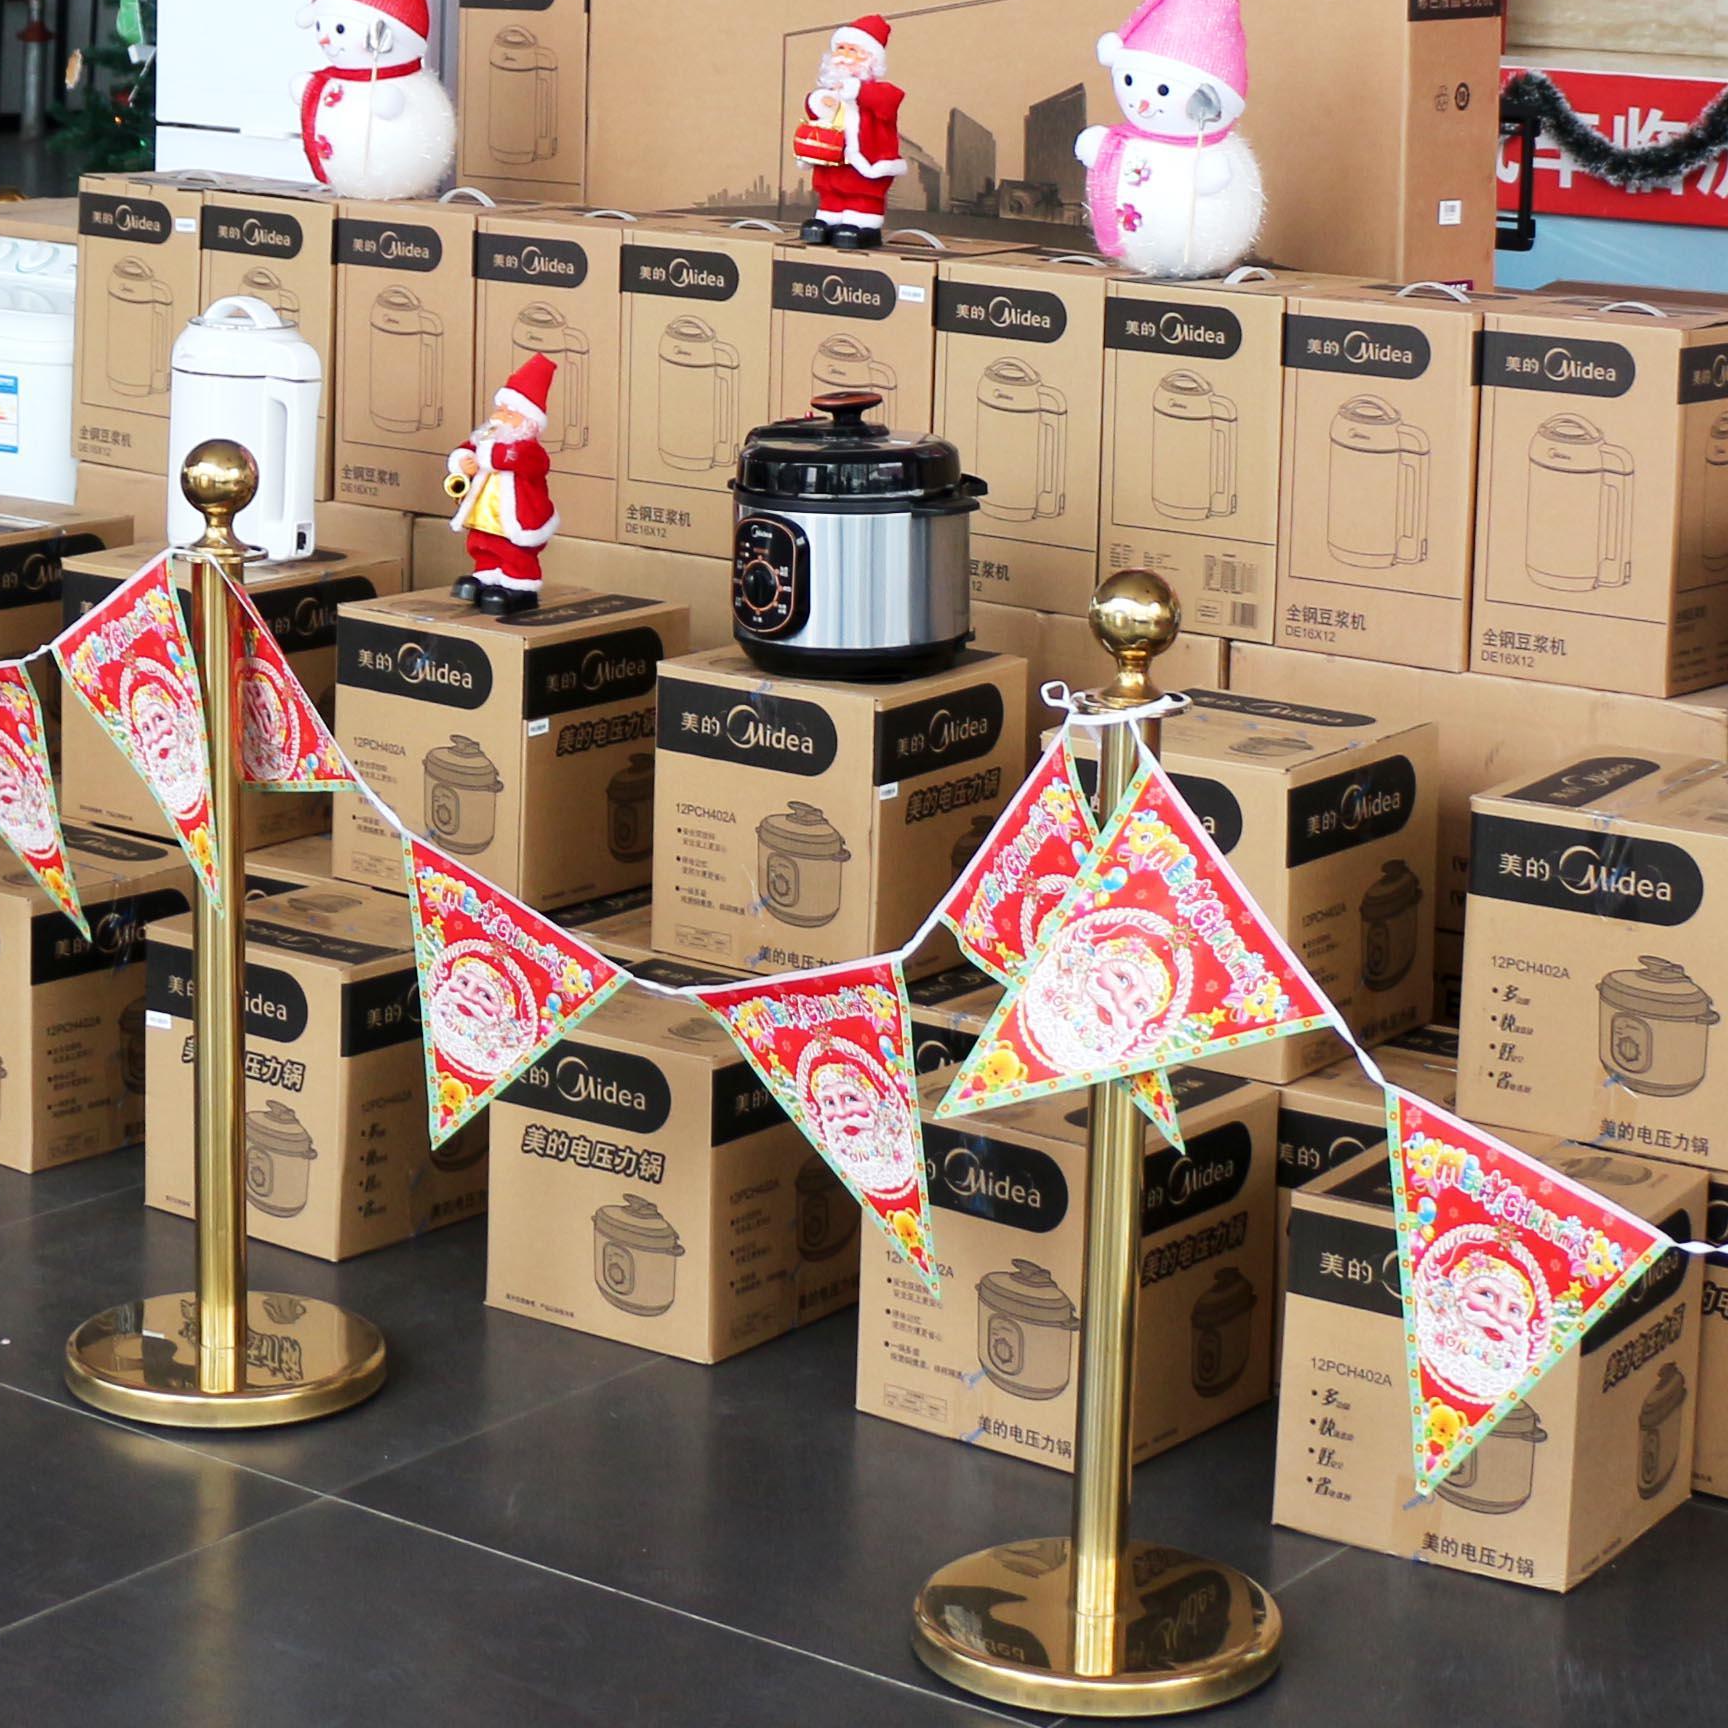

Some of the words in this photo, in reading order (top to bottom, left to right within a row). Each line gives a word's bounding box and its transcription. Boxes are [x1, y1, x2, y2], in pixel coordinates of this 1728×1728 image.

[91, 209, 114, 227] 美的
[114, 203, 162, 235] Midea
[216, 221, 241, 241] 美的
[243, 217, 291, 250] Midea
[351, 235, 377, 254] 美的
[379, 230, 430, 262] Midea
[491, 251, 519, 269] 美的
[520, 245, 575, 277] Midea
[638, 265, 666, 283] 美的
[669, 258, 726, 292] Midea
[791, 282, 819, 299] 美的
[822, 274, 881, 307] Midea
[955, 302, 986, 322] 美的
[988, 295, 1051, 330] Midea
[1124, 318, 1156, 337] 美的
[1159, 311, 1227, 346] Midea
[1306, 337, 1339, 357] 美的
[1343, 330, 1413, 365] Midea
[1504, 354, 1540, 375] 美的
[1544, 347, 1617, 383] Midea
[77, 424, 133, 449] 全钢豆浆机
[340, 464, 401, 489] 全钢豆浆机
[624, 521, 668, 540] DE16X12
[625, 503, 692, 529] 全钢豆浆机
[1284, 625, 1336, 644] DE16X12
[1285, 604, 1367, 632] 全钢豆浆机
[1480, 648, 1535, 669] DE16X12
[1481, 627, 1567, 658] 全钢豆浆机
[357, 648, 393, 671] 美的
[397, 642, 473, 689] Midea
[545, 670, 578, 692] 美的
[580, 648, 647, 690] Midea
[352, 734, 407, 757] 12PCH402A
[556, 712, 656, 757] 美的电压力锅
[680, 711, 720, 736] 美的
[725, 703, 814, 756] Midea
[896, 733, 925, 757] 美的
[928, 708, 989, 754] Midea
[675, 801, 737, 825] 12PCH402A
[905, 767, 1002, 825] 美的电压力锅
[1306, 810, 1336, 838] 美的
[1339, 783, 1402, 832] Midea
[1499, 853, 1550, 881] 美的
[1558, 844, 1672, 902] Midea
[437, 879, 498, 938] MERRY
[495, 911, 570, 978] CHRISTMAS
[1144, 829, 1219, 923] MERRY
[1190, 897, 1270, 997] CHRISTMAS
[54, 935, 90, 959] 美的
[96, 915, 146, 953] Mid
[758, 943, 843, 971] 美的电压
[1489, 954, 1571, 981] 12PCH402A
[244, 990, 288, 1022] idea
[366, 1004, 402, 1026] 美的
[753, 995, 810, 1034] MERRY
[803, 985, 877, 1029] CHRISTMAS
[556, 1056, 647, 1111] Midea
[521, 1124, 667, 1184] 美的电压力锅
[1600, 1118, 1710, 1156] 美的电压力锅
[1279, 1142, 1321, 1170] 美的
[944, 1146, 1042, 1208] Midea
[1167, 1156, 1235, 1207] Midea
[1434, 1143, 1504, 1214] MERRY
[1501, 1184, 1597, 1270] CHRISTMAS
[884, 1250, 955, 1279] 12P2A
[1140, 1211, 1248, 1288] 美的电压力锅
[1318, 1249, 1373, 1284] 美的
[1309, 1356, 1393, 1389] 12PCH402A
[977, 1414, 1072, 1459] 美的电压力锅
[1421, 1530, 1535, 1579] 美的电压力锅
